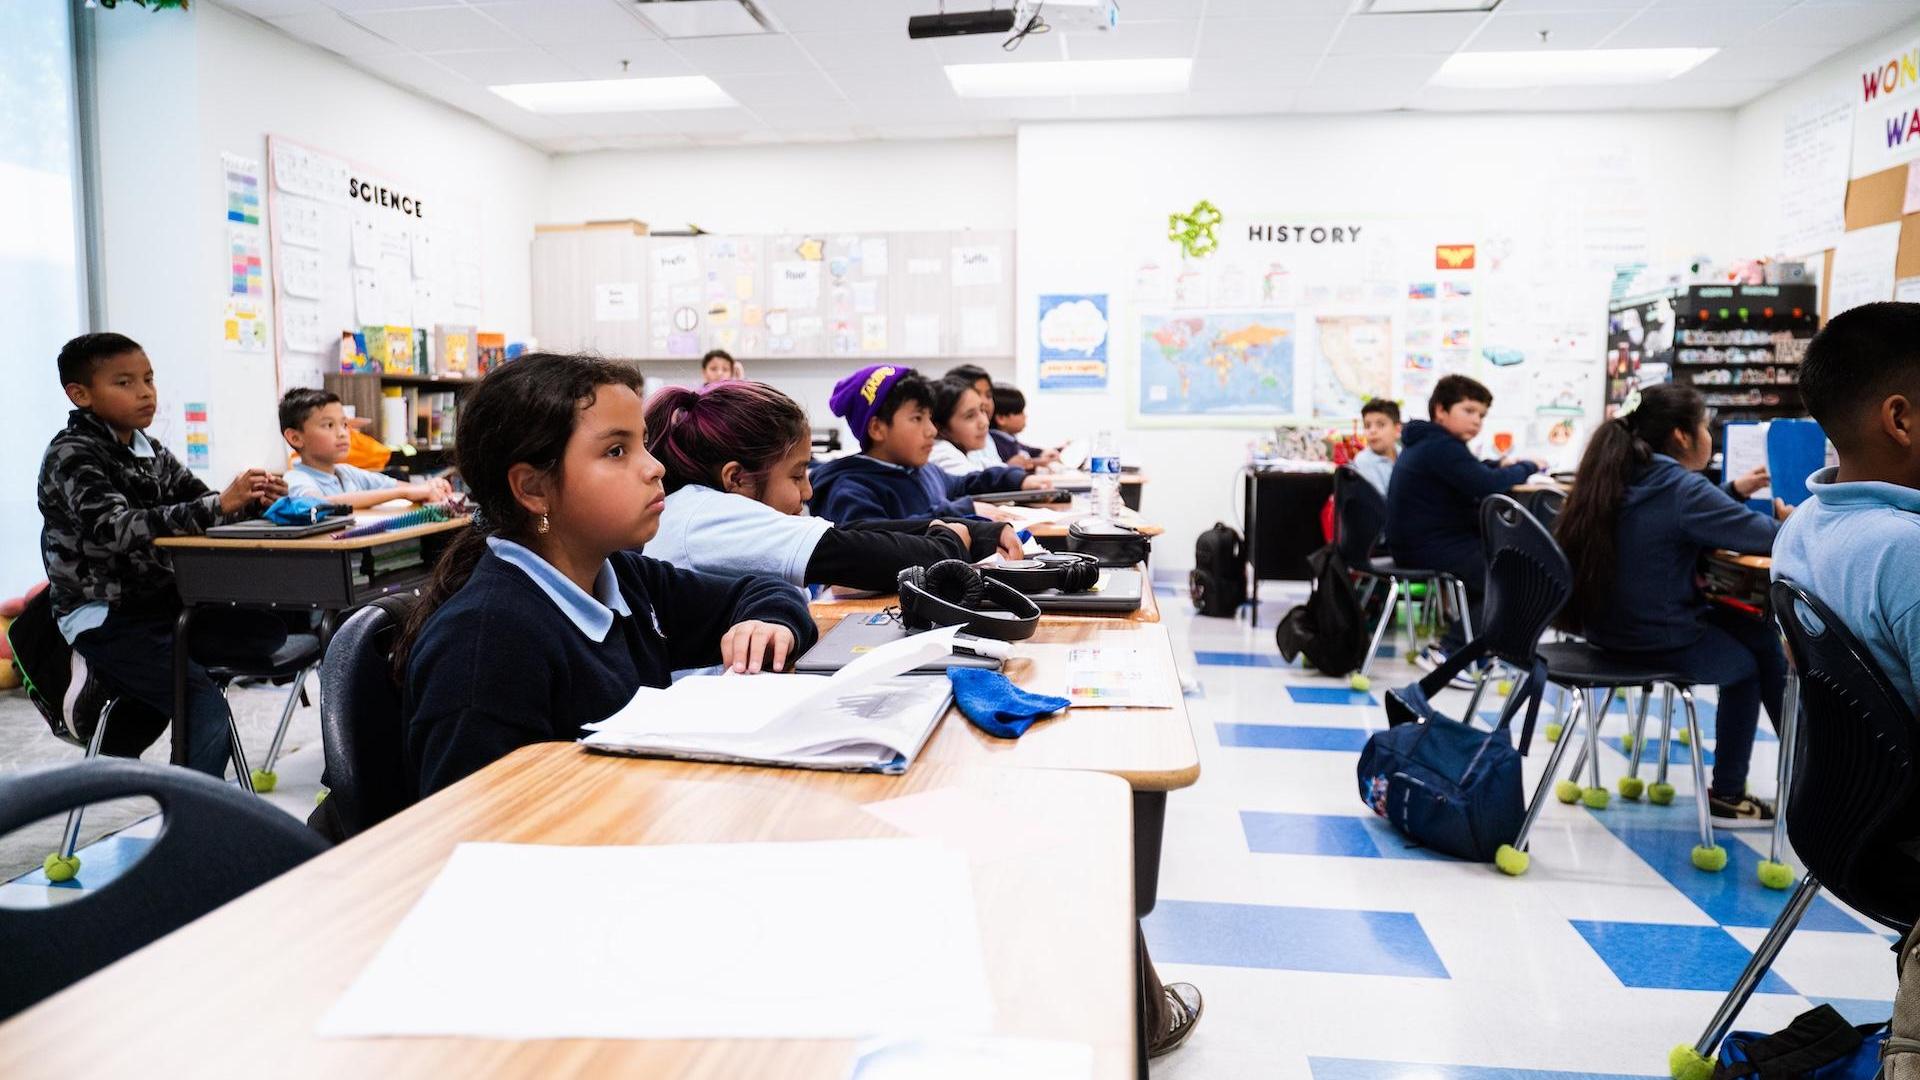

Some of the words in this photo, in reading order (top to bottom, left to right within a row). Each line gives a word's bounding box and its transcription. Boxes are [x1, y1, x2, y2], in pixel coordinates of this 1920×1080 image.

[1862, 48, 1920, 102] WON
[349, 177, 422, 218] SCIENCE
[1248, 225, 1361, 244] HISTORY
